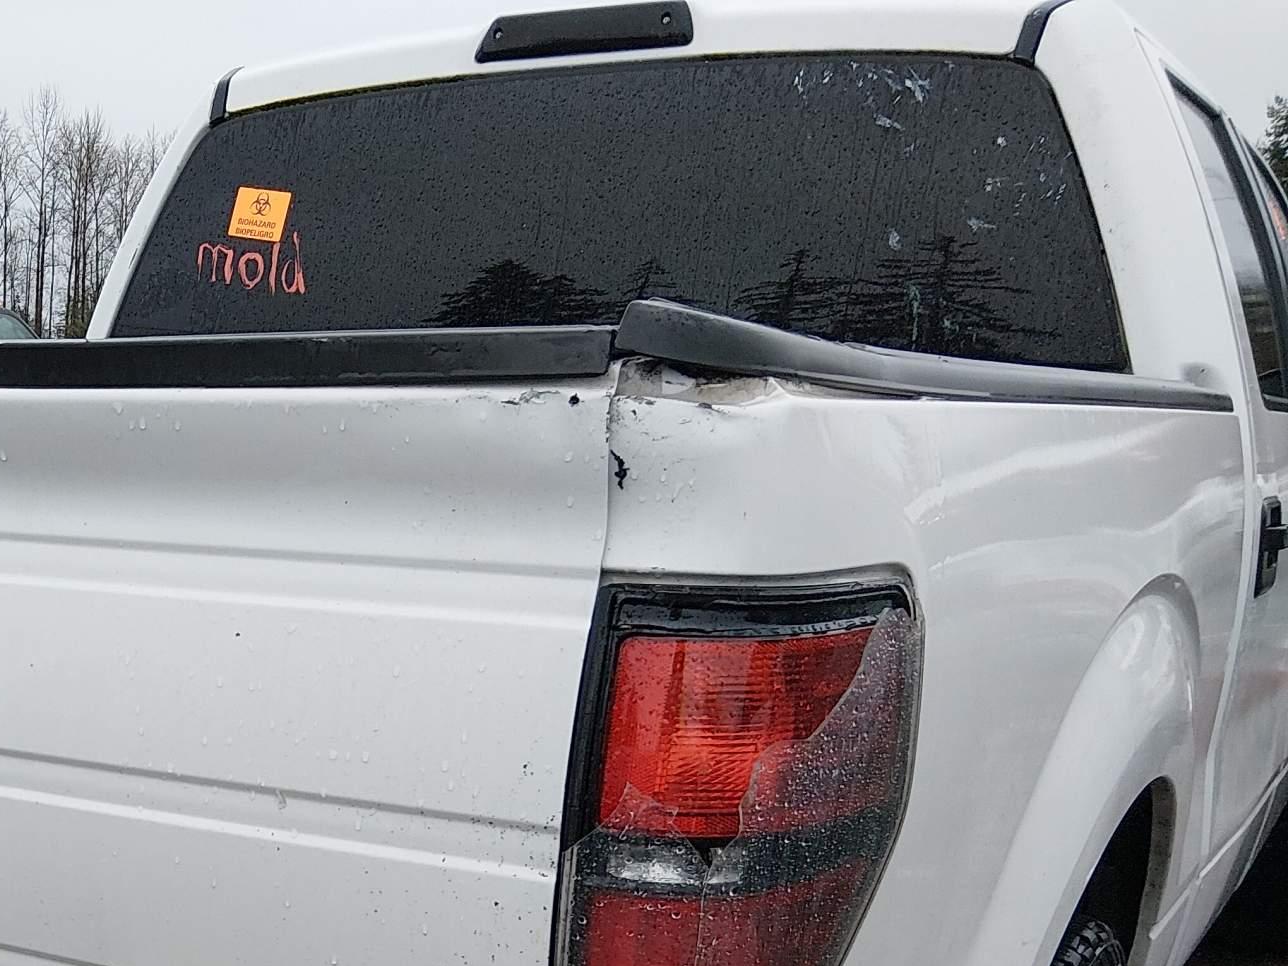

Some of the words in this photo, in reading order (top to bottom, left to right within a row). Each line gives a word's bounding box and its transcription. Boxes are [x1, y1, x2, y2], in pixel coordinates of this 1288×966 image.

[237, 217, 277, 230] BIOHAZARD
[234, 227, 275, 239] BIOPELIGRO
[196, 231, 306, 297] mold
